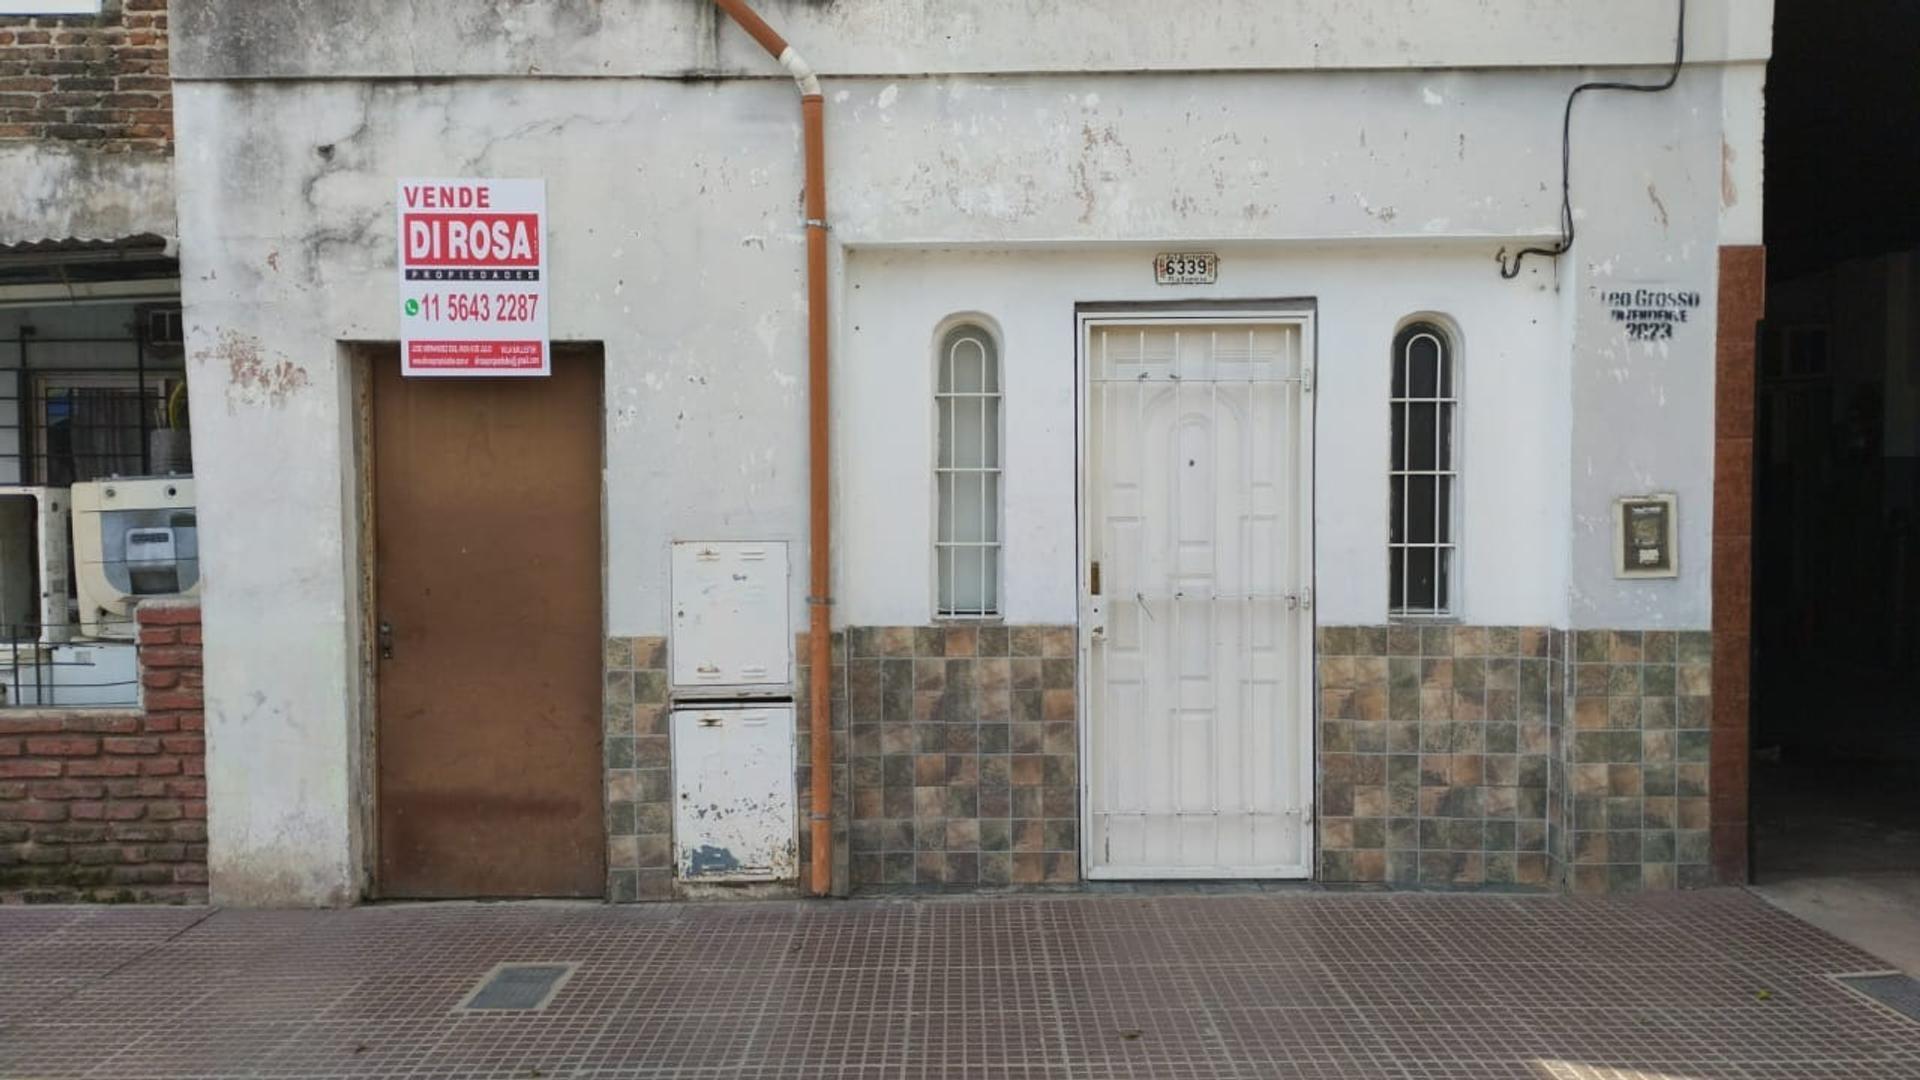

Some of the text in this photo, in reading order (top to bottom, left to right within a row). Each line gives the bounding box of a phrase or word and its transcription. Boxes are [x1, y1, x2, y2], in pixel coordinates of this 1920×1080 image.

[403, 186, 490, 208] VENDE
[409, 220, 441, 260] DI
[448, 219, 533, 261] ROSA
[411, 271, 534, 280] PROPIEDADES
[1166, 259, 1206, 276] 6339
[421, 293, 539, 322] 11 5643 2287
[1635, 289, 1700, 308] Grosso
